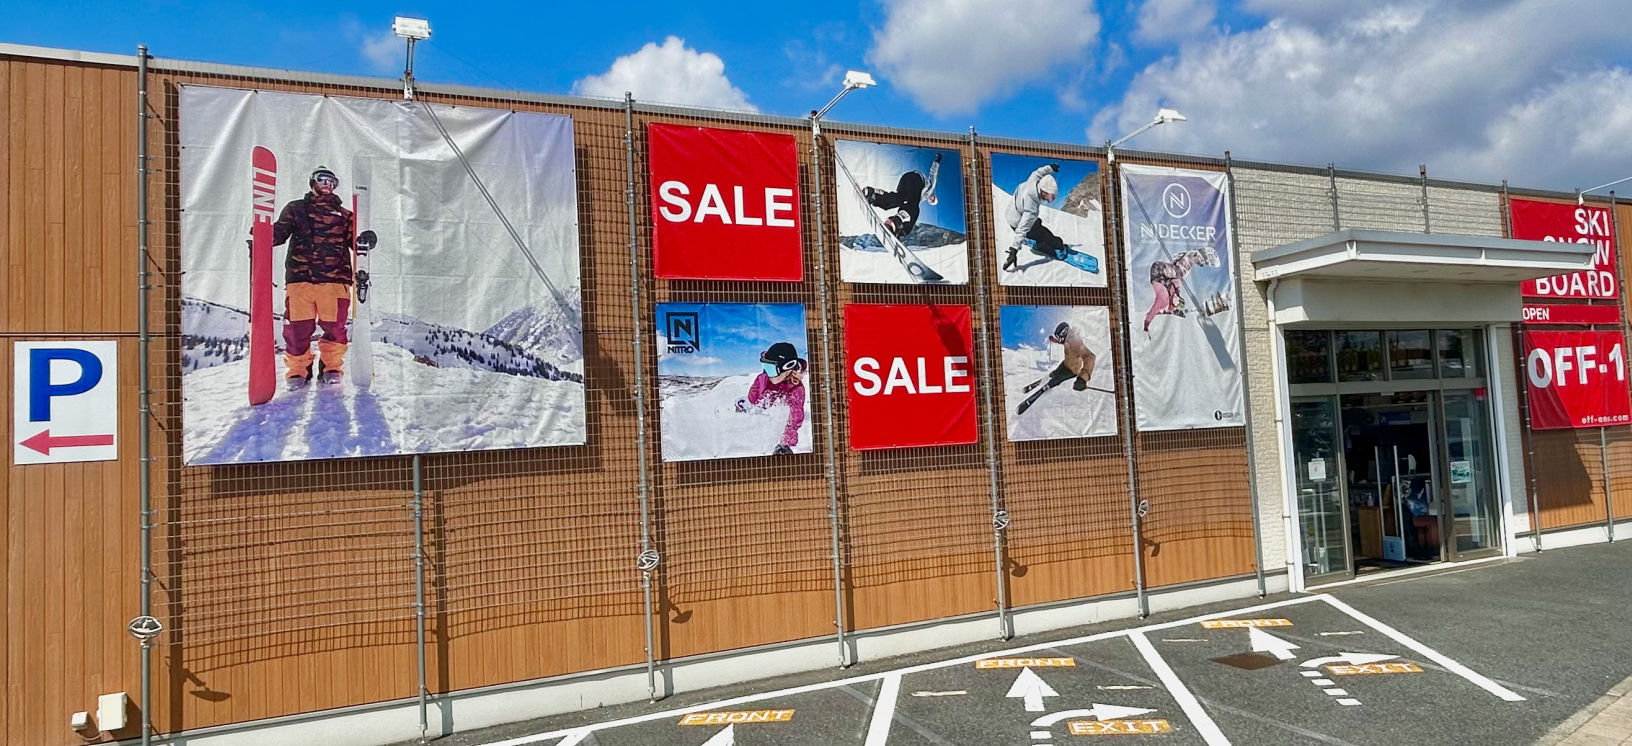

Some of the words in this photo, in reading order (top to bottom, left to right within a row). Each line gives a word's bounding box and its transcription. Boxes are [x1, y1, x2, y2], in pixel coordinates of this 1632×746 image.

[253, 166, 276, 226] LINE
[659, 180, 795, 227] SALE
[1140, 222, 1217, 241] NIDECKER
[1574, 208, 1610, 237] SKI
[1535, 270, 1615, 297] BOARD
[1522, 307, 1550, 321] OPEN
[667, 345, 695, 354] NITRO
[853, 355, 971, 396] SALE
[1527, 343, 1625, 388] OFF-1
[29, 347, 103, 423] P
[979, 658, 1073, 669] FRONT
[1331, 662, 1414, 674] EXIT
[683, 709, 791, 724] FRONT
[1071, 720, 1164, 733] EXIT
